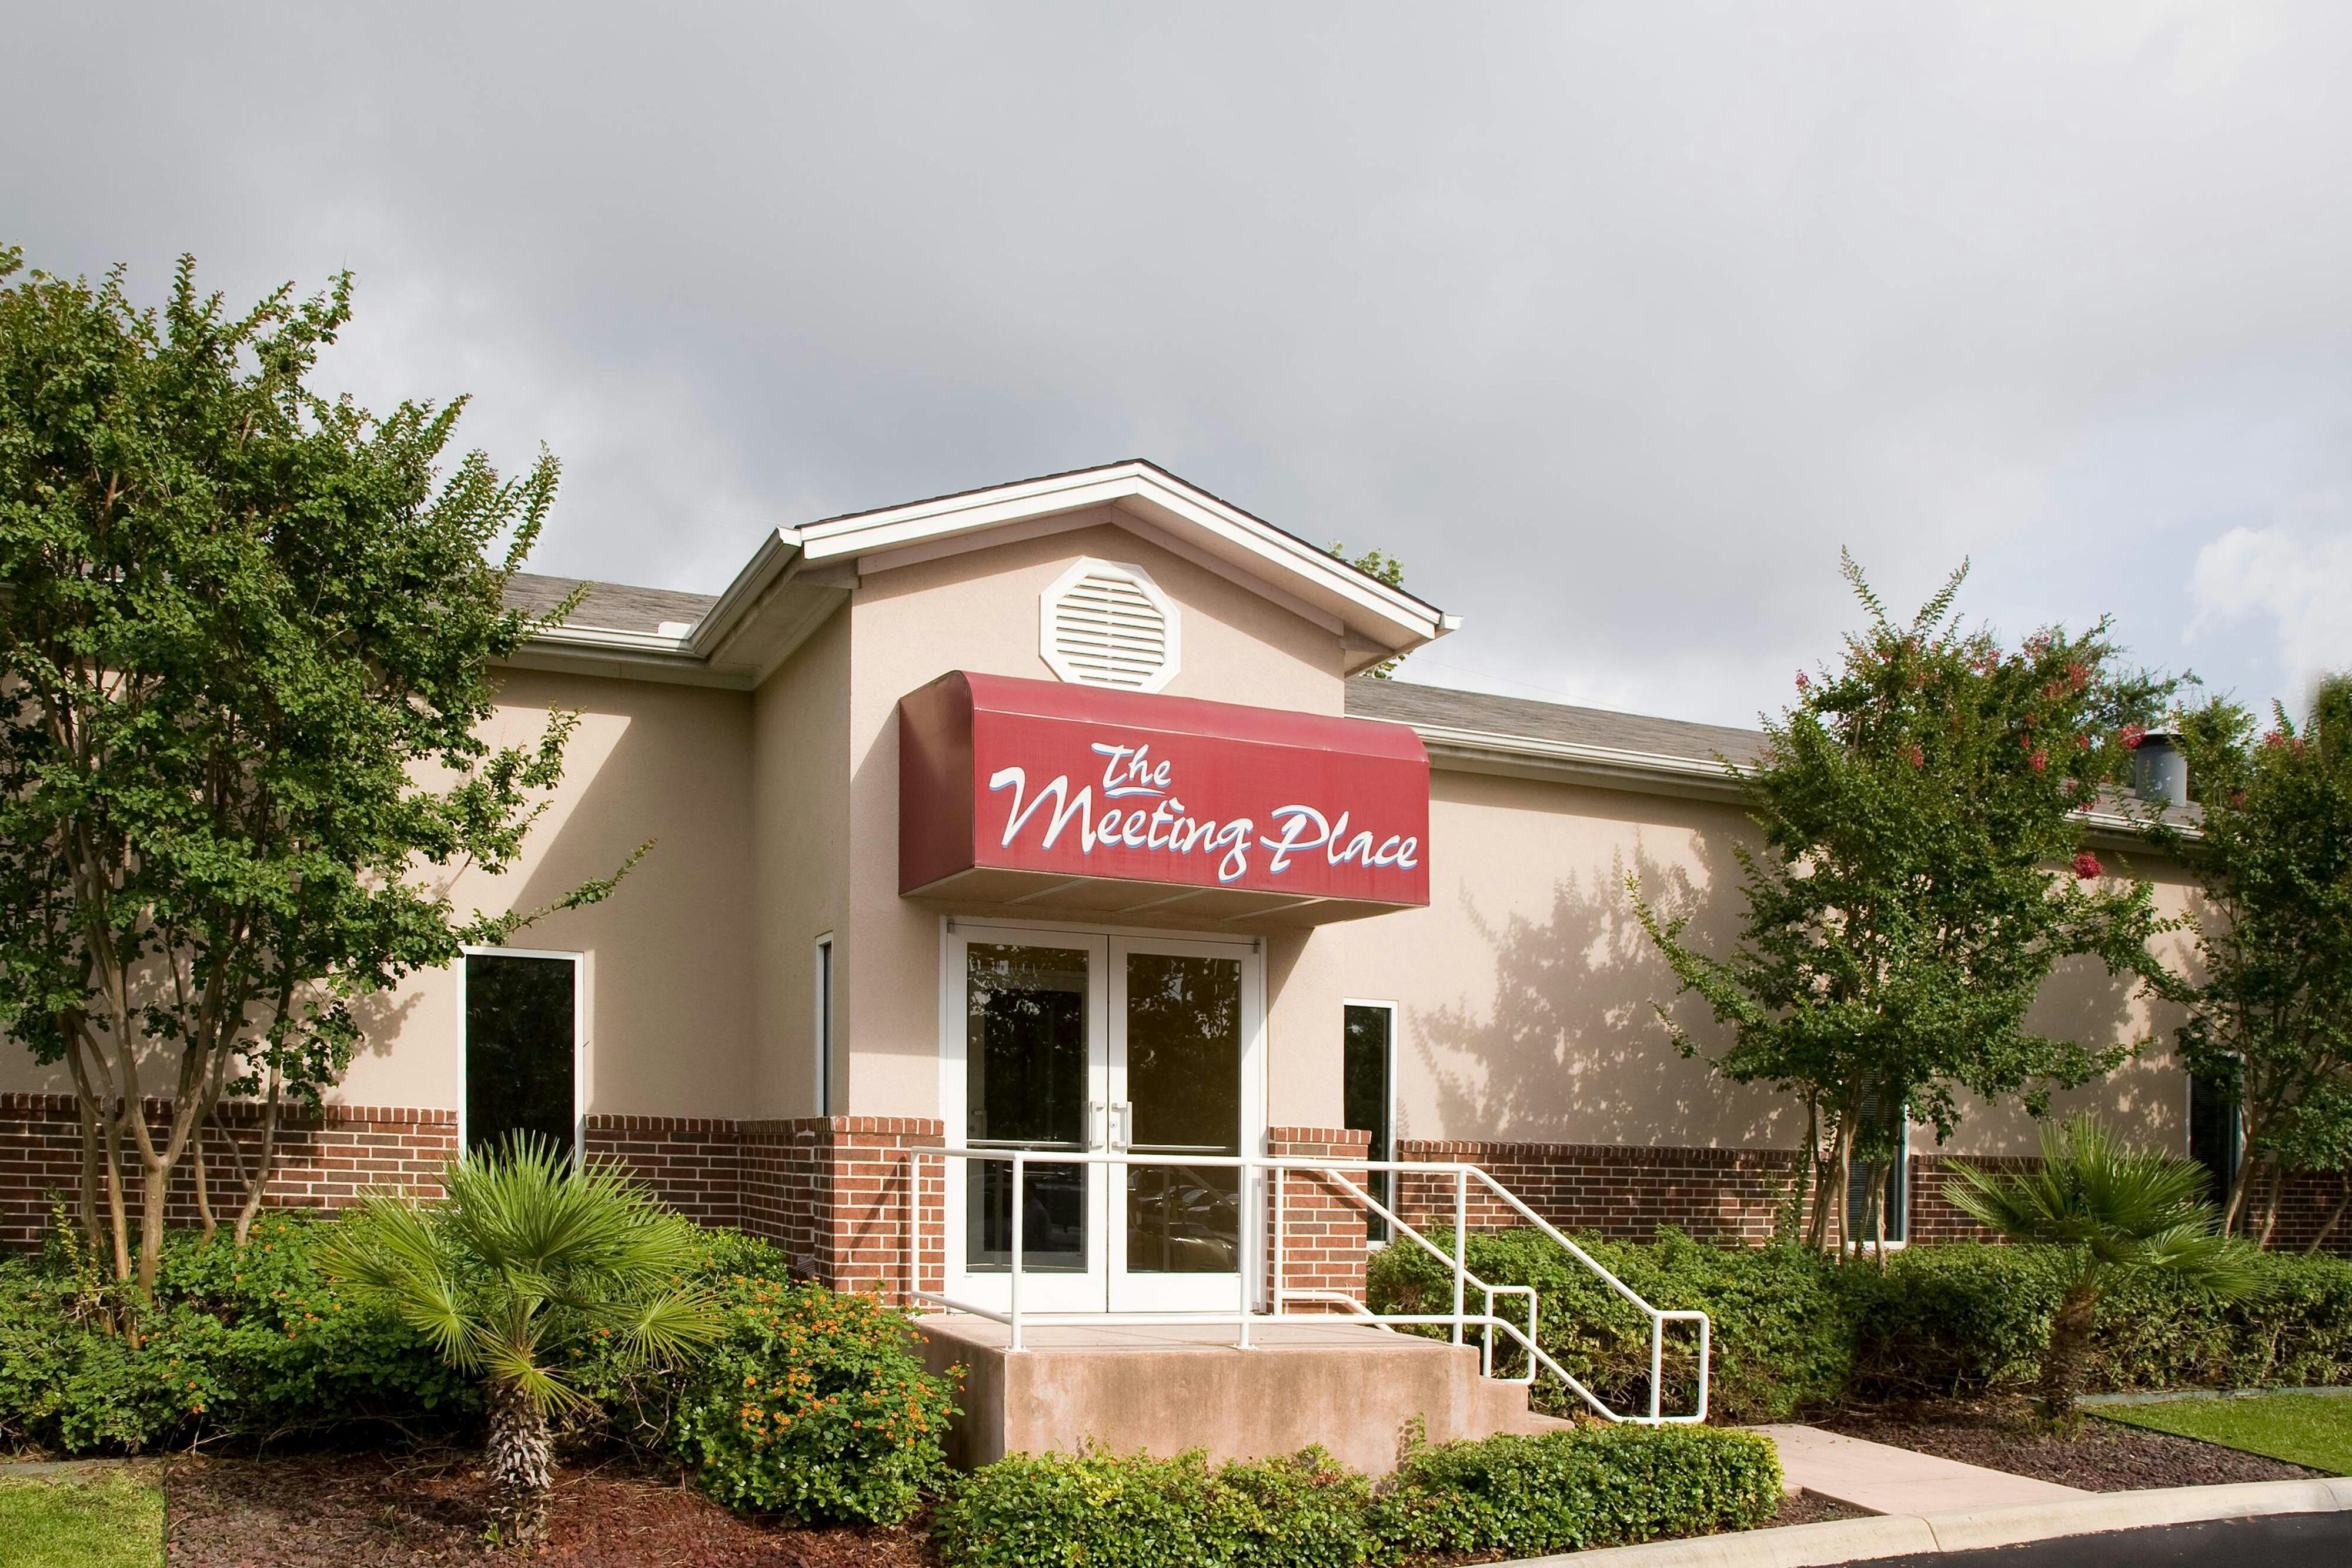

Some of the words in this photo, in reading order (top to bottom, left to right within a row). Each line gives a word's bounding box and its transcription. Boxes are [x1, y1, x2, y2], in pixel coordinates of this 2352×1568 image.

[1091, 742, 1172, 790] The
[989, 766, 1254, 884] Meeting
[1260, 804, 1419, 874] Place
